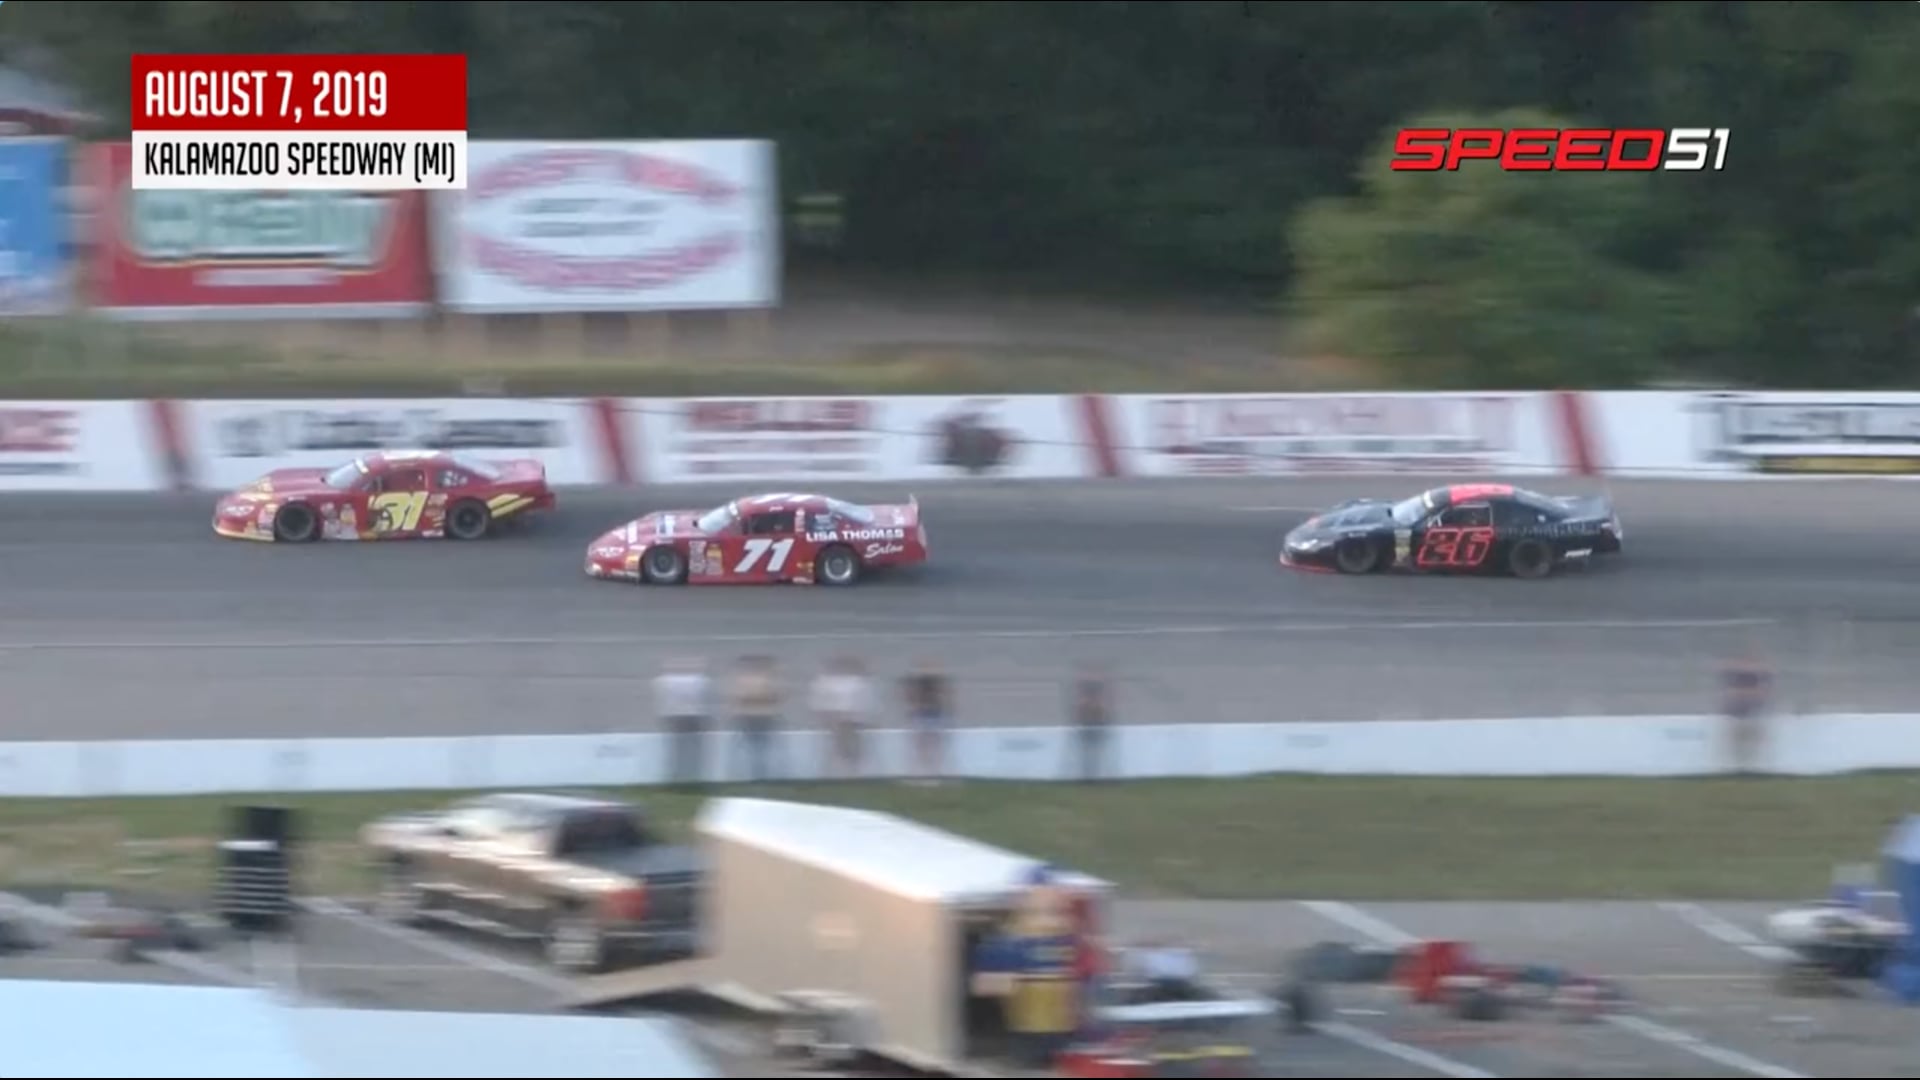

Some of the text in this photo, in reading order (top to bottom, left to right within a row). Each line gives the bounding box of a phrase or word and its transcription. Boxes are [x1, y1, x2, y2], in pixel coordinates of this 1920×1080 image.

[368, 491, 429, 531] 31
[806, 528, 905, 542] LISA THOMAS
[1416, 527, 1495, 565] 26
[734, 538, 795, 573] 71
